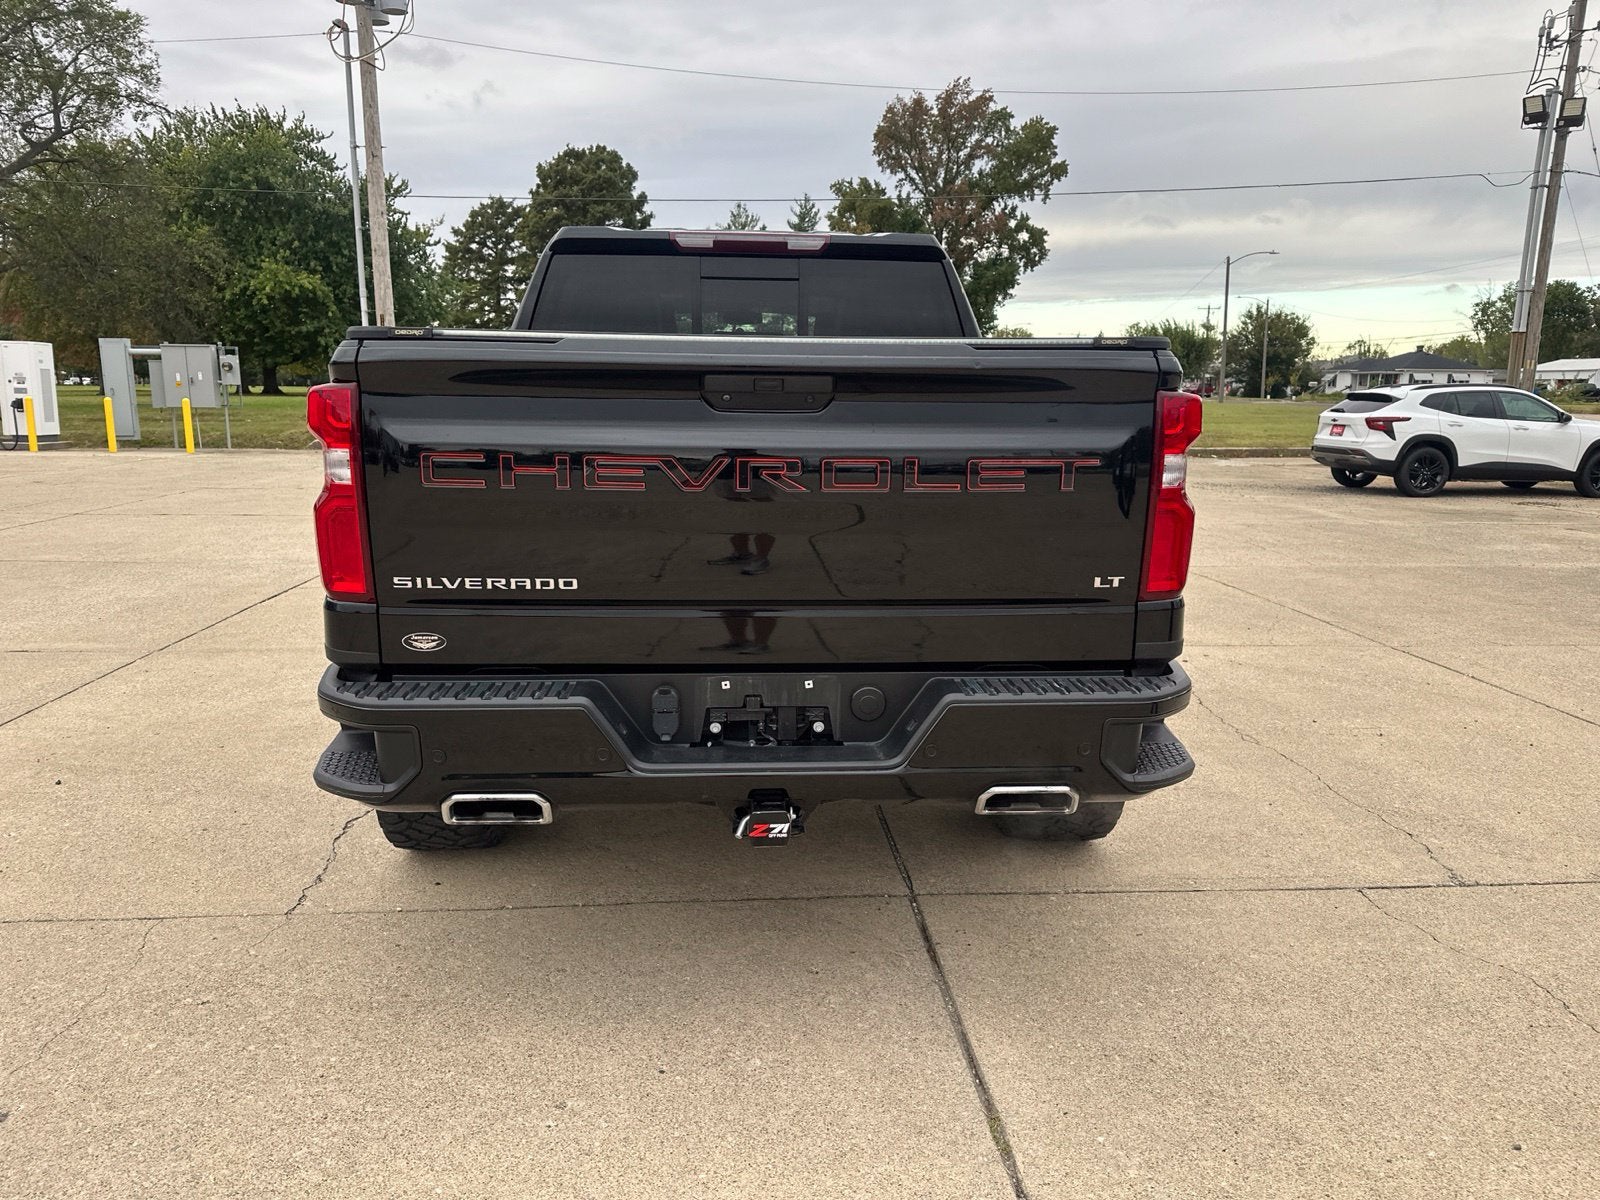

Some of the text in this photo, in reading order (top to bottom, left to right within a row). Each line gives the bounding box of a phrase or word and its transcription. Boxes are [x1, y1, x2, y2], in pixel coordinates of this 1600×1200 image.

[420, 452, 1101, 492] CHEVROLET
[393, 576, 578, 590] SILVERADO
[1093, 576, 1125, 588] LT
[749, 823, 790, 837] Z71
